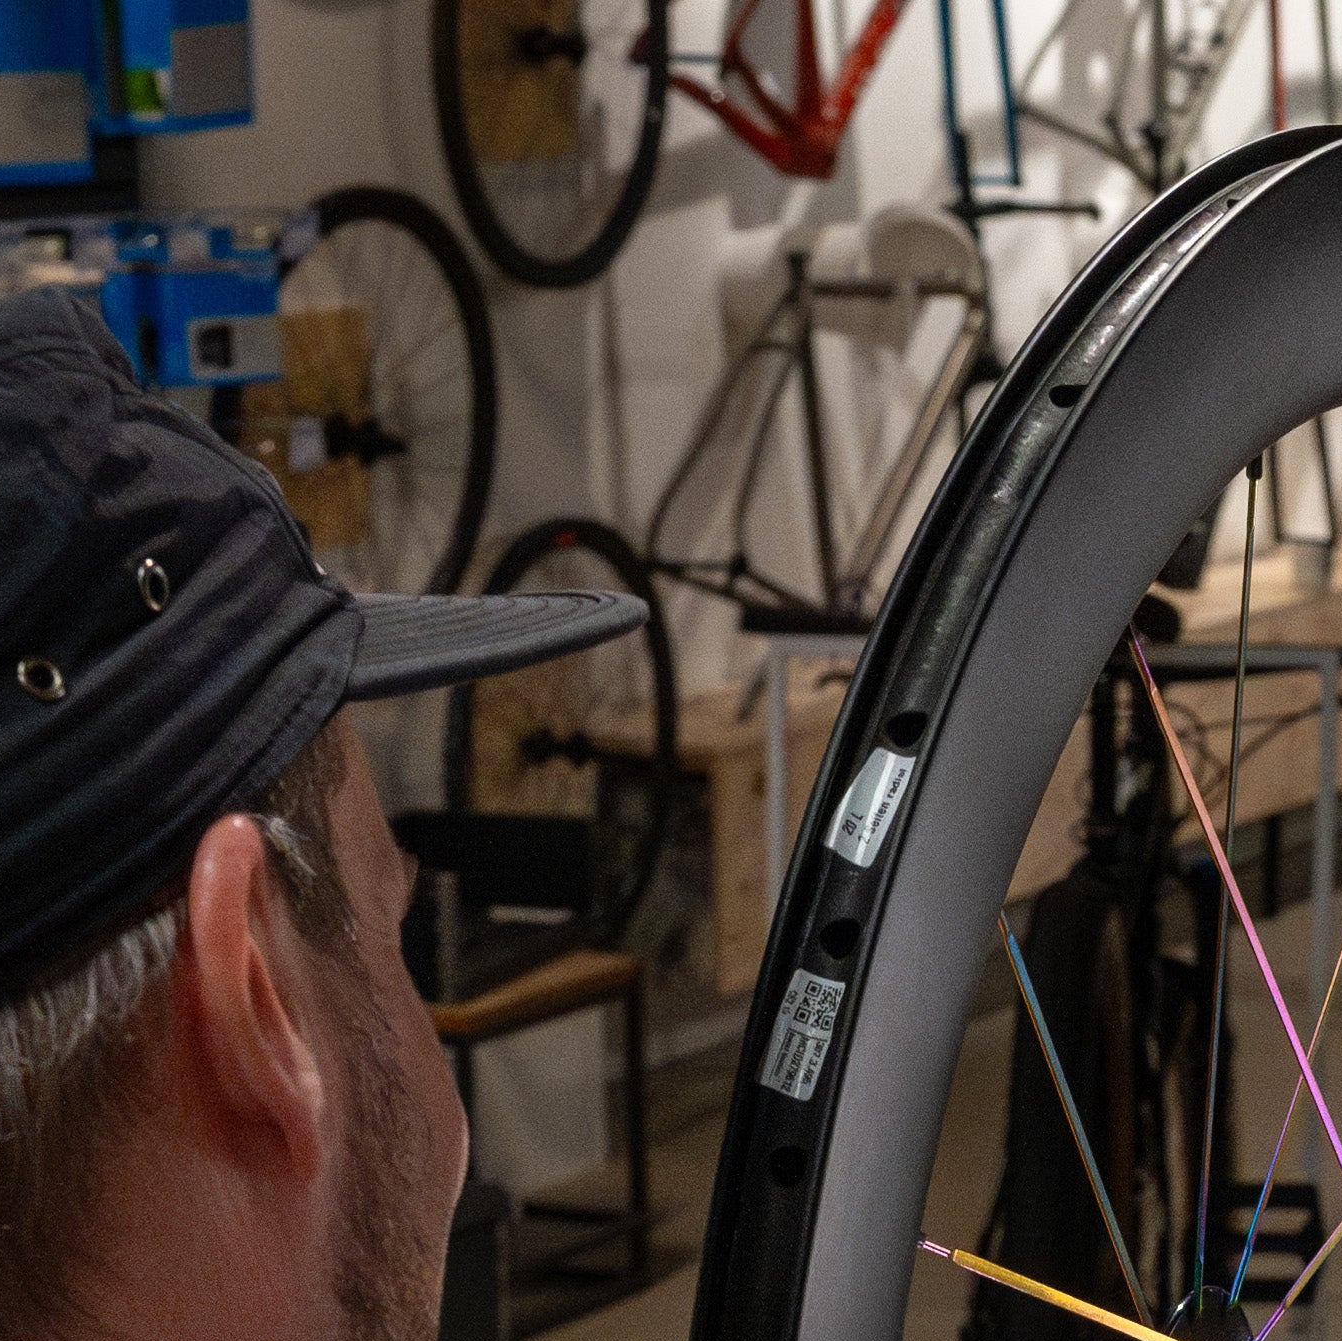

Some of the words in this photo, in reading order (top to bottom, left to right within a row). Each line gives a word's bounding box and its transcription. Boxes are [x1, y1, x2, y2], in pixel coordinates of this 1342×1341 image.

[887, 768, 907, 799] radial
[842, 820, 857, 835] 20
[850, 812, 864, 821] L
